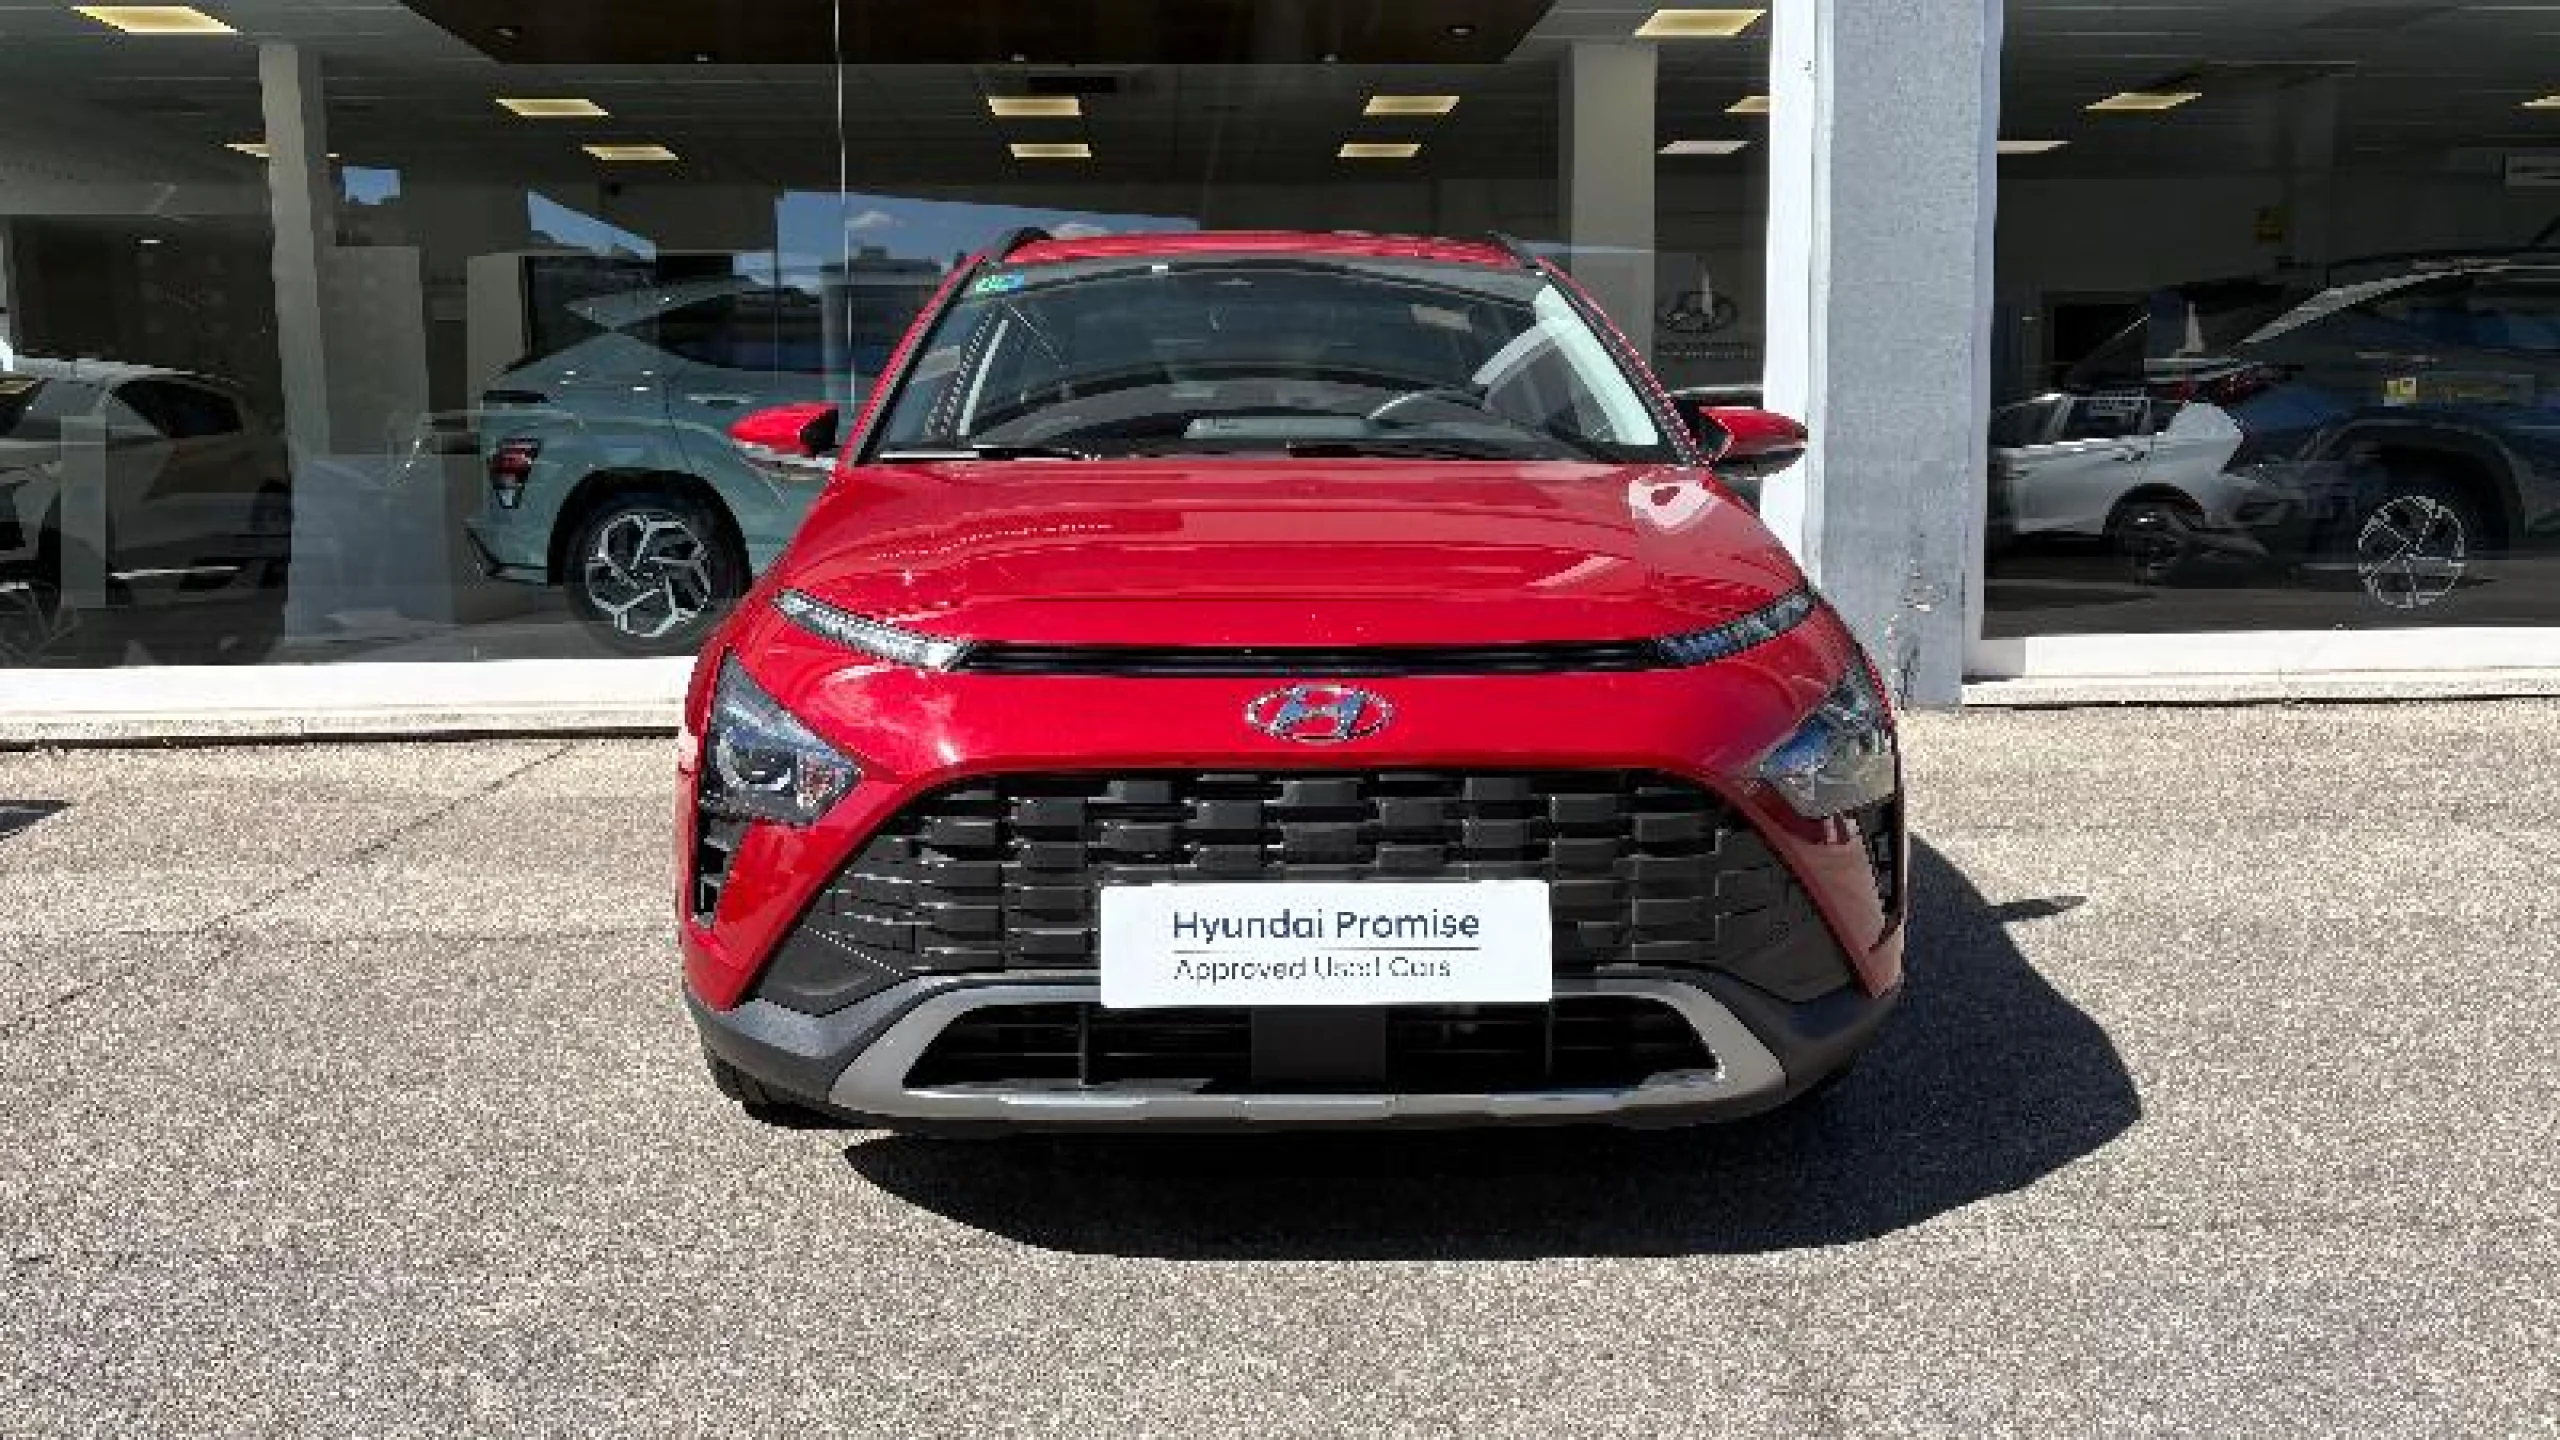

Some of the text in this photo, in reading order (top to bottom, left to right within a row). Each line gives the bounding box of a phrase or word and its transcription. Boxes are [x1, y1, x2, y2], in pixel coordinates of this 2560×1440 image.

[1173, 908, 1479, 944] Hyundai Promise
[1173, 956, 1307, 985] Approved
[1388, 955, 1451, 979] Cars
